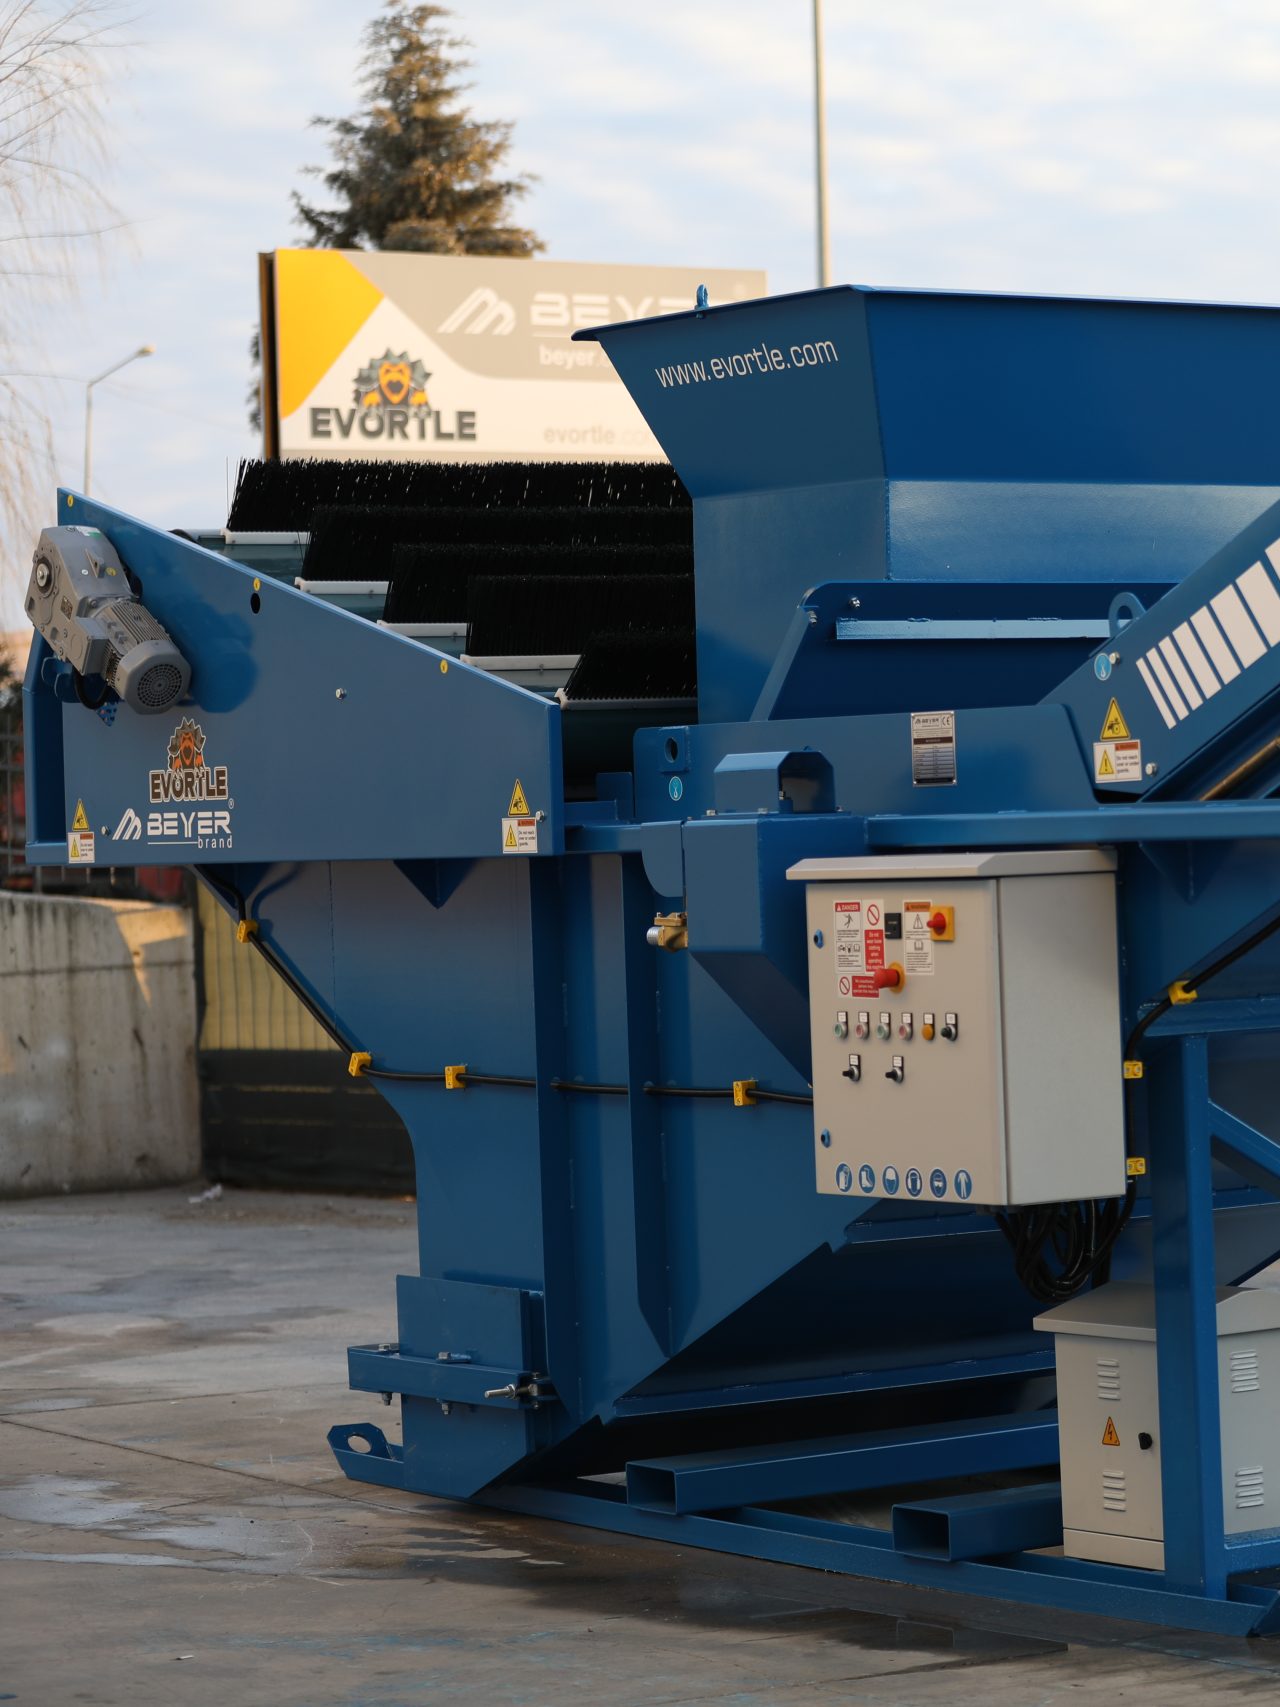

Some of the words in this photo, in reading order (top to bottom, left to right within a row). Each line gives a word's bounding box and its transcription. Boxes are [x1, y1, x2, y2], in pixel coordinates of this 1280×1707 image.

[655, 341, 839, 388] www.evortle.com
[310, 407, 477, 441] EVORTLE
[149, 766, 228, 803] EVORTLE
[147, 811, 231, 838] BEYER
[197, 834, 232, 849] brand
